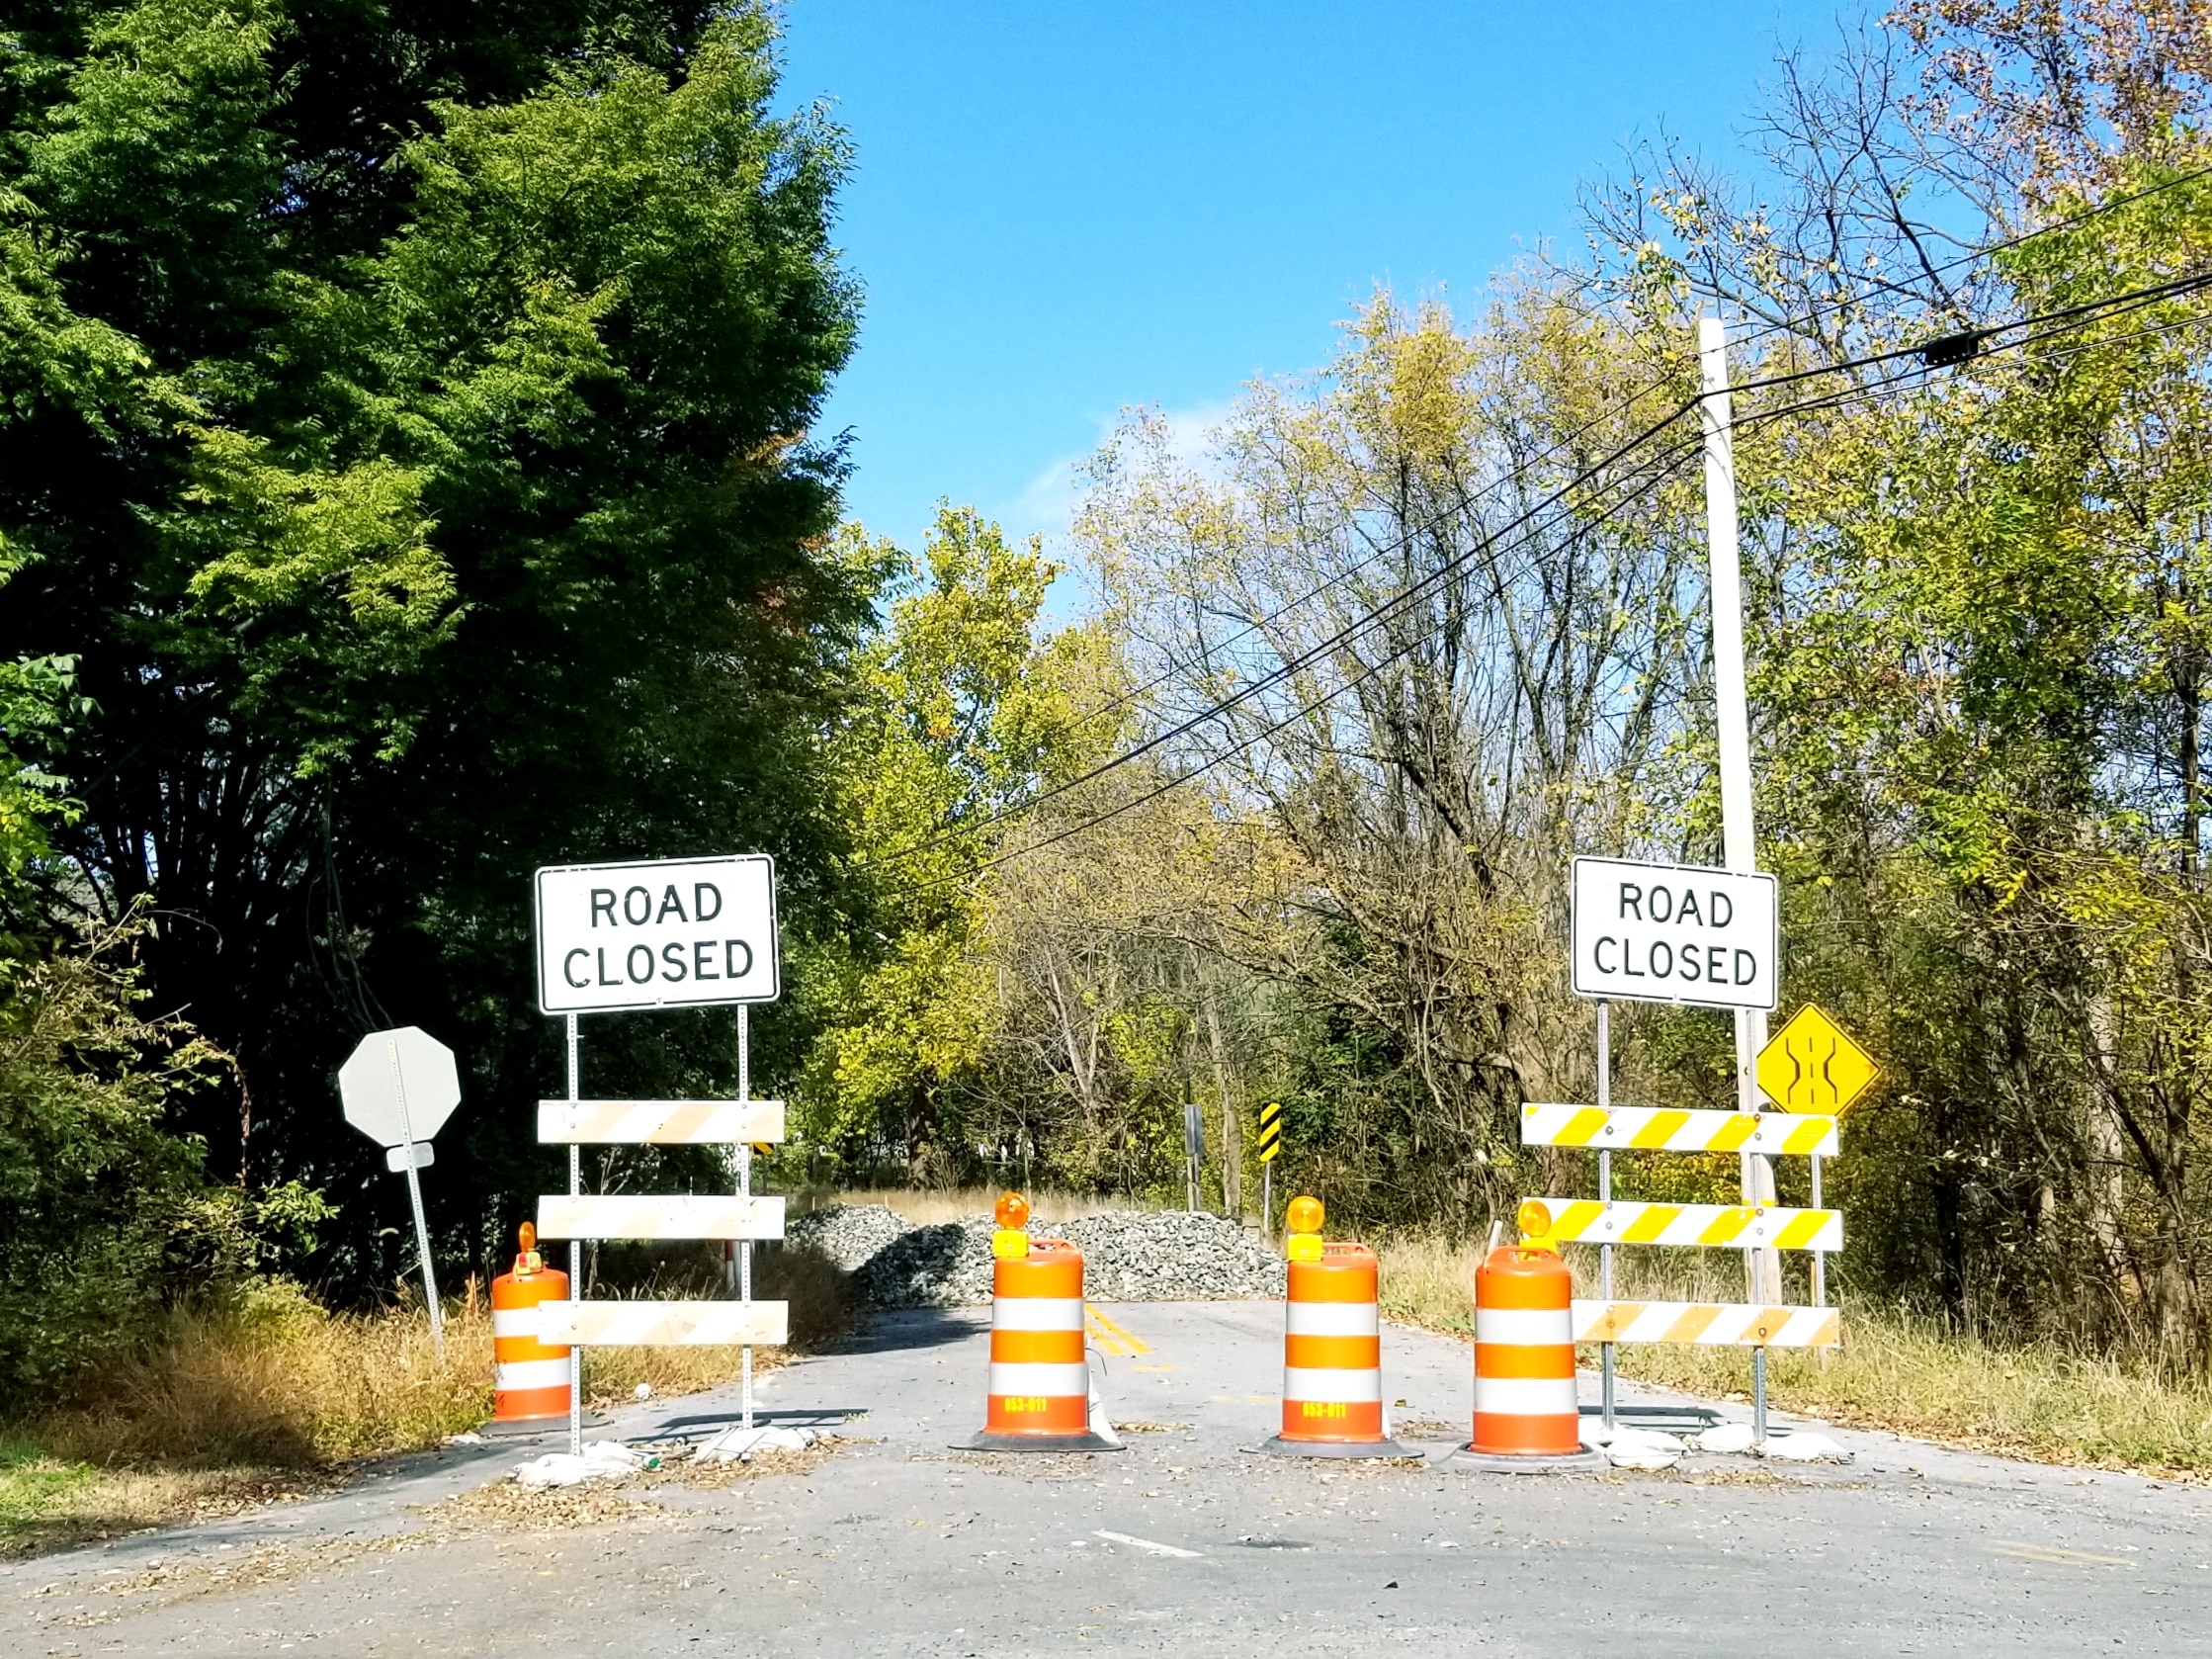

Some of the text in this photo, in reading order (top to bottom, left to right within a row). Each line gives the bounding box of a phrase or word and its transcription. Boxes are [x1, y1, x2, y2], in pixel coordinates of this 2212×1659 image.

[590, 882, 723, 927] ROAD
[1619, 882, 1734, 928] ROAD
[563, 938, 754, 988] CLOSED
[1593, 935, 1757, 986] CLOSED
[1302, 1401, 1345, 1418] 053-011
